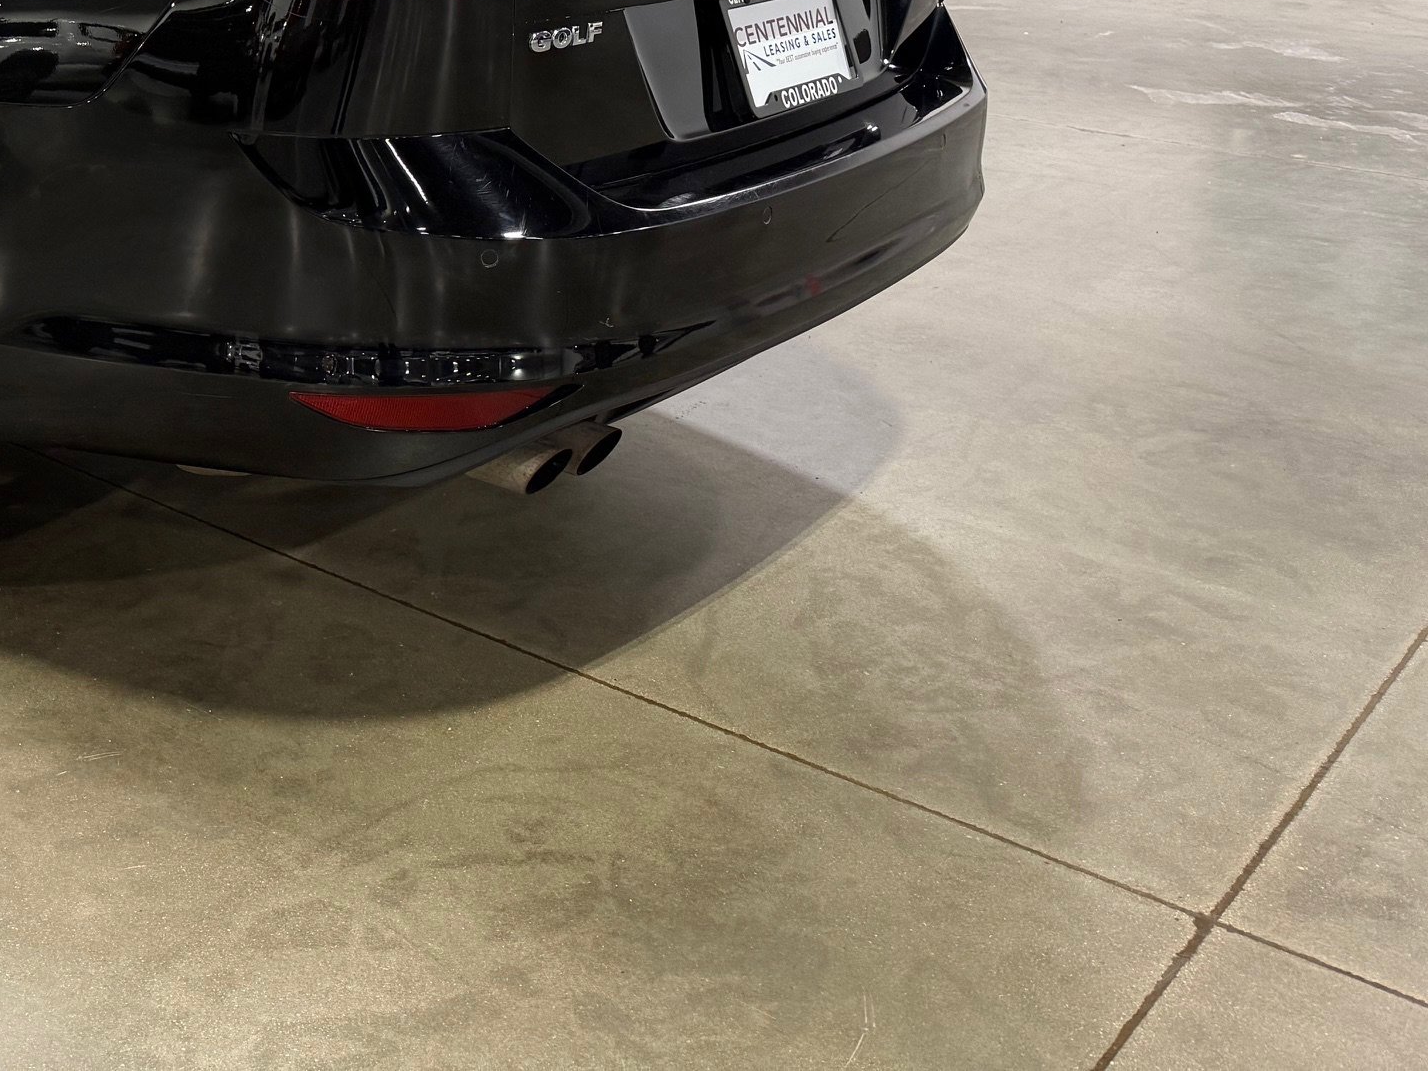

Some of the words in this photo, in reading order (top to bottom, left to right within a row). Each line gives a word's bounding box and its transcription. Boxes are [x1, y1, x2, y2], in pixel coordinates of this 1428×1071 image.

[529, 21, 603, 53] GOLF
[734, 6, 834, 48] CENTENNIAL
[763, 37, 801, 57] LEASING
[804, 35, 810, 46] &
[812, 27, 837, 44] SALES
[781, 76, 838, 109] COLORADO
